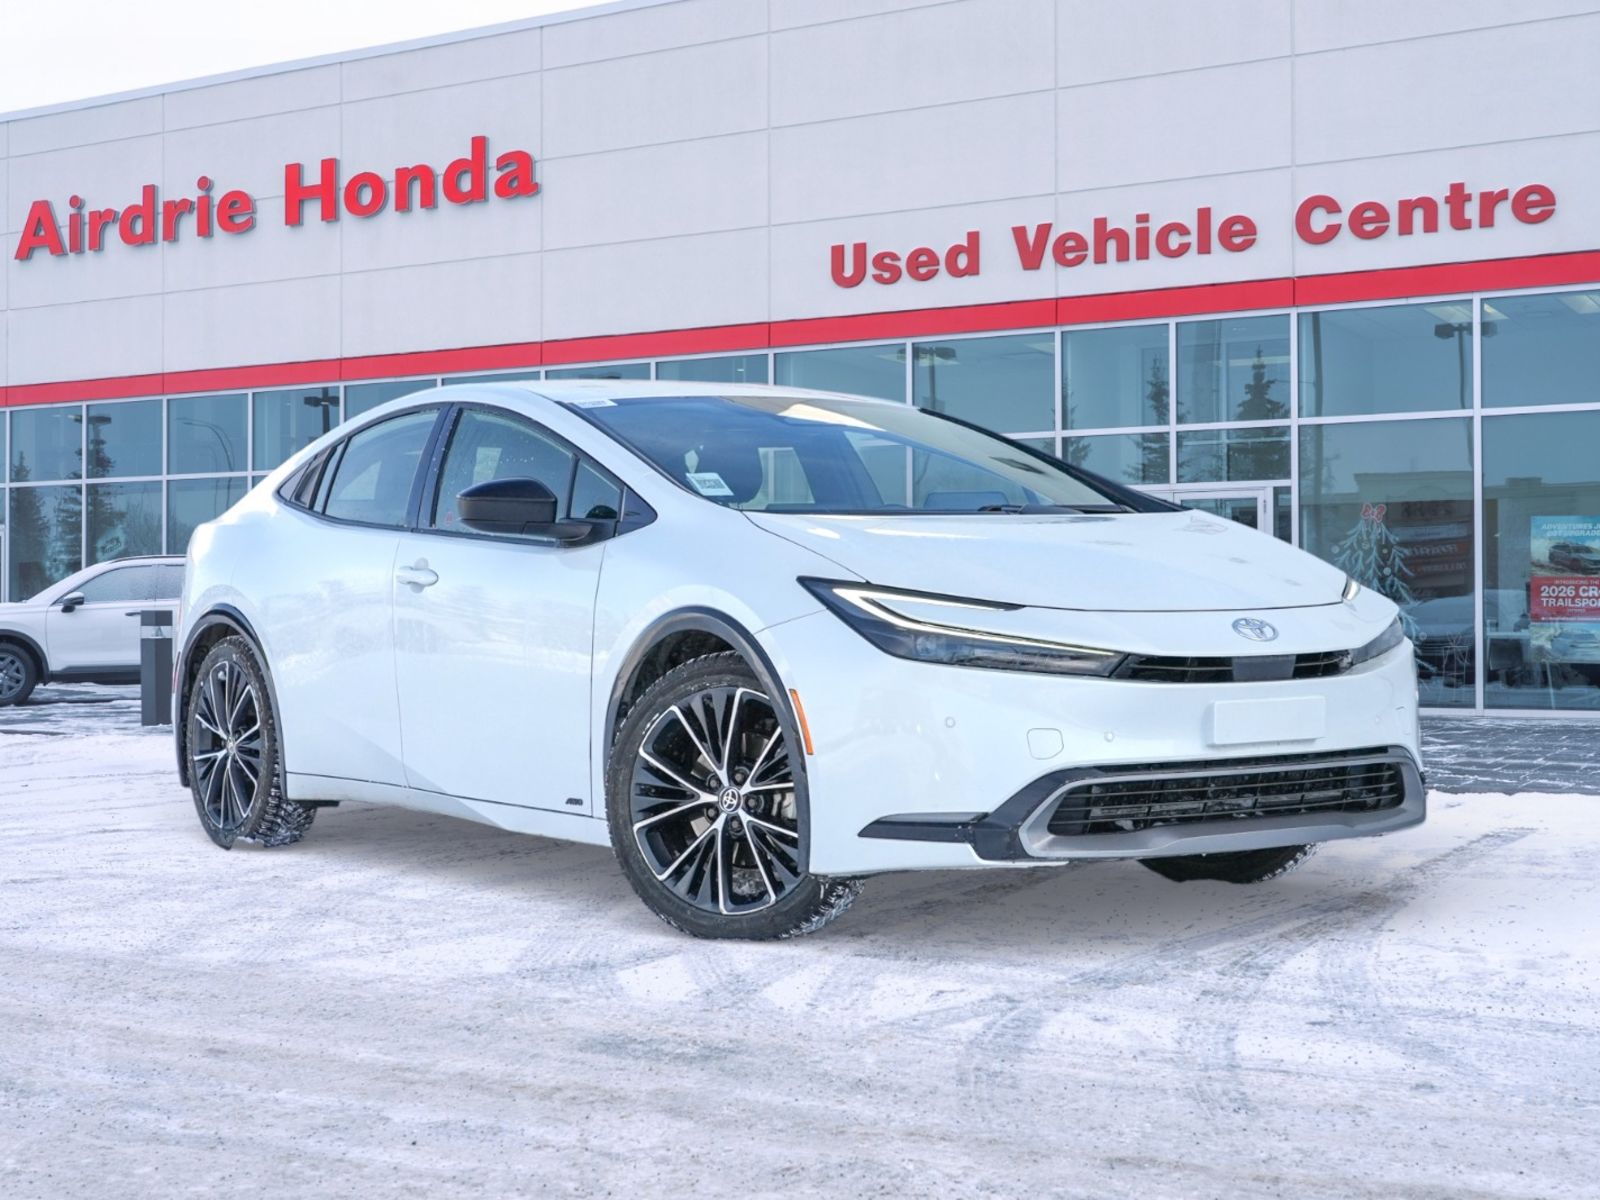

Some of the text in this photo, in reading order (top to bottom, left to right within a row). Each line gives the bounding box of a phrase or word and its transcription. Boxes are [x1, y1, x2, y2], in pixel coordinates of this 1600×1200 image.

[15, 135, 540, 260] Airdrie Honda
[831, 182, 1557, 288] Used Vehicle Centre
[1540, 585, 1576, 597] 2026
